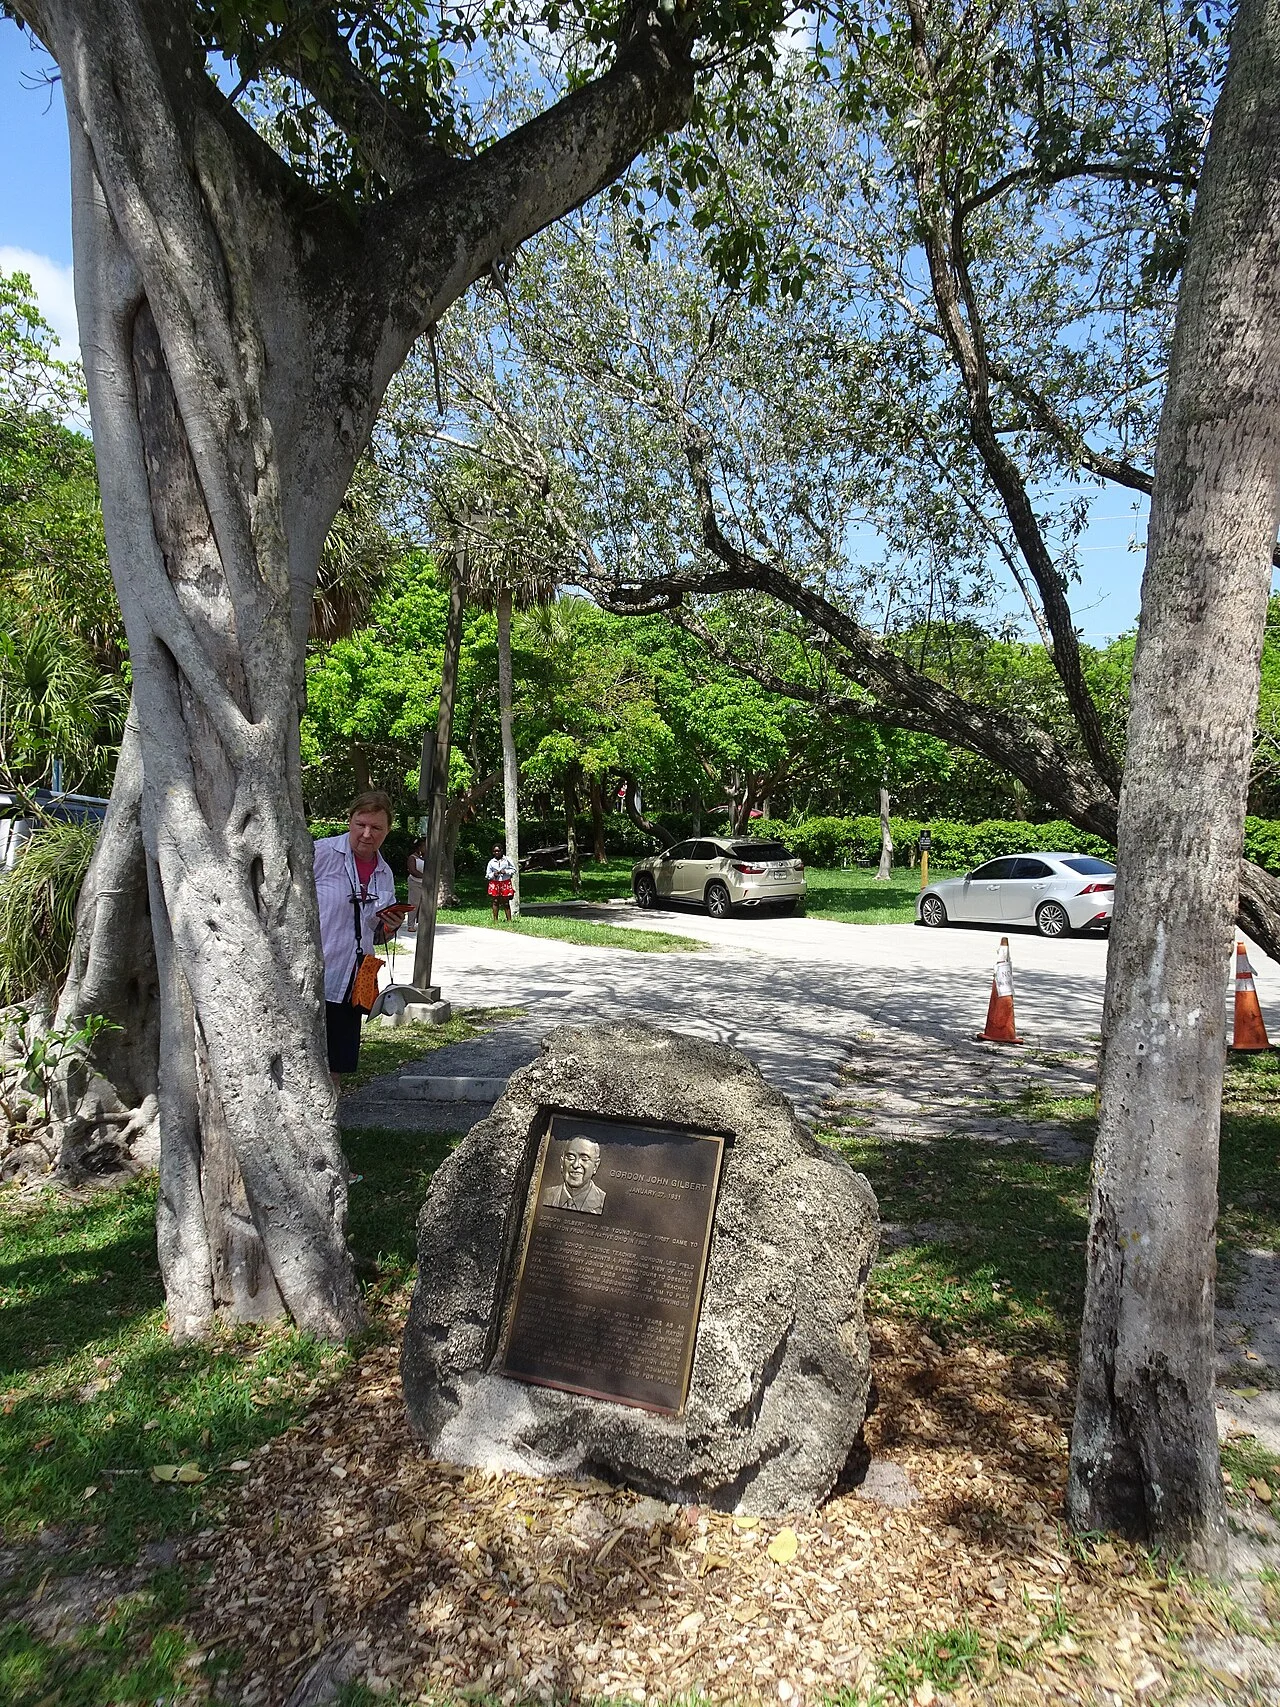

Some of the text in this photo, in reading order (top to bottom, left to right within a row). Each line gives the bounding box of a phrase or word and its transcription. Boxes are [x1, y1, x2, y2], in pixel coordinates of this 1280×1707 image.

[610, 1170, 708, 1192] GORDON JOHN GILBERT
[630, 1187, 655, 1198] JANUARY
[611, 1227, 629, 1235] YOUNG
[632, 1231, 650, 1239] FAMILY
[654, 1235, 670, 1243] FIRST
[672, 1238, 687, 1246] CAME
[564, 1241, 585, 1250] SCHOOL
[587, 1245, 609, 1254] SCIENCE
[639, 1255, 663, 1264] GORDON
[678, 1262, 694, 1270] FIELD
[583, 1252, 610, 1262] STUDENTS
[676, 1269, 693, 1277] THEIR
[614, 1265, 637, 1274] EVENING
[639, 1270, 656, 1278] TOURS
[574, 1273, 600, 1282] TEACHING
[575, 1265, 594, 1274] LAYING
[621, 1274, 639, 1282] ALONG
[656, 1296, 679, 1306] SERVING
[643, 1316, 662, 1325] YEARS
[618, 1319, 642, 1329] GREATER
[646, 1325, 661, 1333] BOCA
[665, 1329, 684, 1338] RATON
[655, 1335, 682, 1346] ADVISORY
[624, 1368, 639, 1377] LAND
[657, 1376, 676, 1385] PUBLIC
[644, 1365, 678, 1377] COMMUNITY
